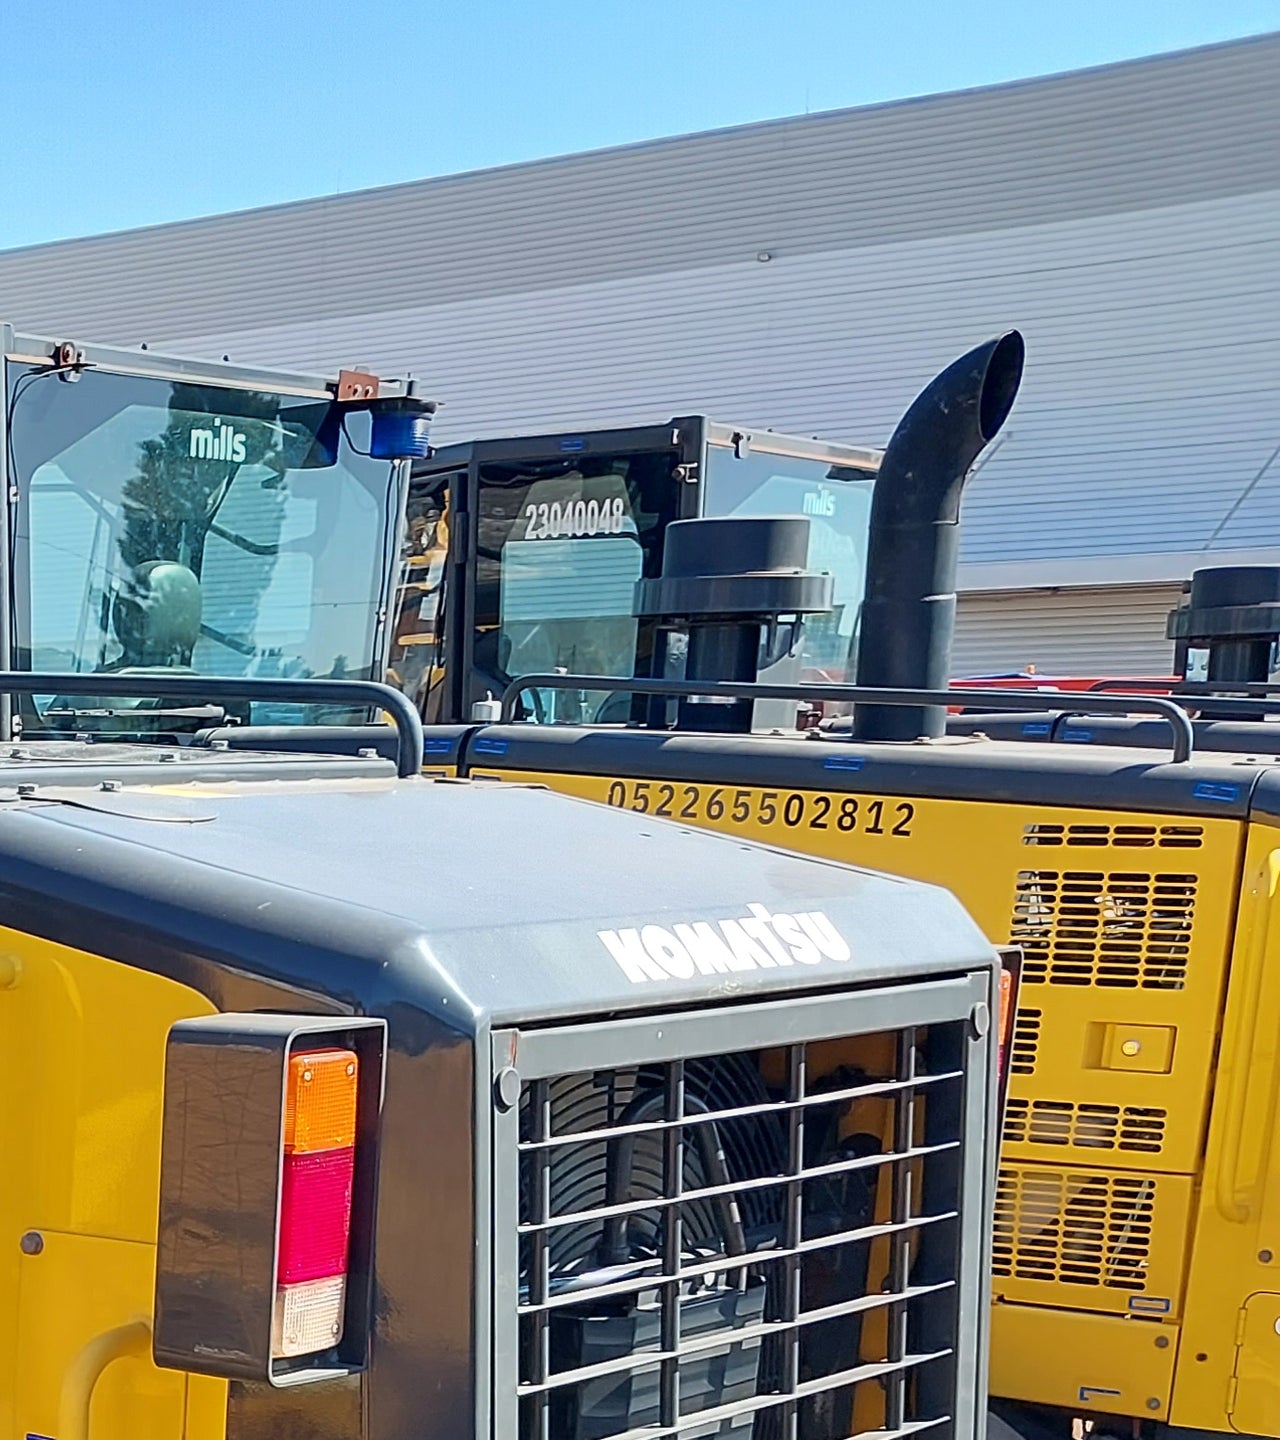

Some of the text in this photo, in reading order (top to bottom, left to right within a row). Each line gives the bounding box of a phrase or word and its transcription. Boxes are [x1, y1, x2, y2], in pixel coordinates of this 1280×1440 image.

[189, 417, 247, 463] mills
[524, 498, 624, 540] 23040048
[608, 780, 915, 838] 052265502812
[597, 903, 852, 984] KOMATSU
